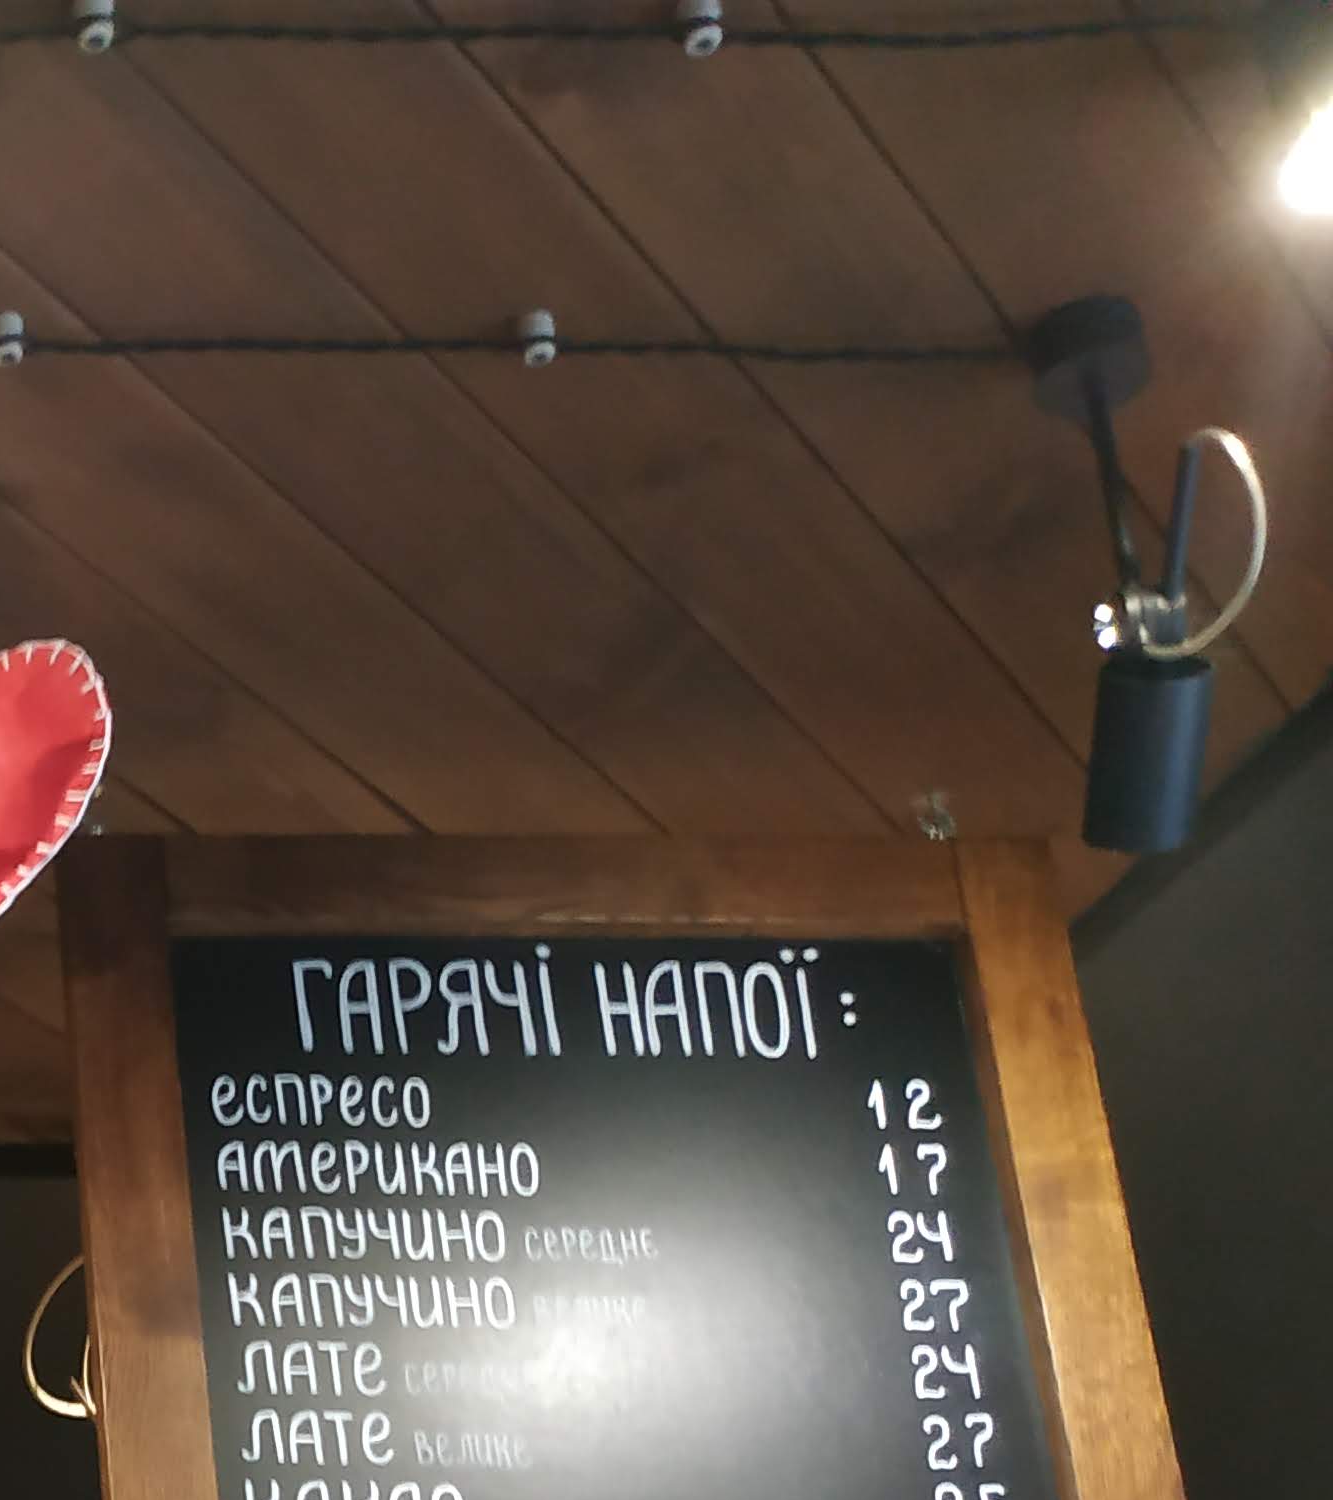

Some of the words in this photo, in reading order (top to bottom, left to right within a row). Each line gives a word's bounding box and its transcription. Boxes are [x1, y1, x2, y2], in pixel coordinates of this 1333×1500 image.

[291, 943, 562, 1057] ГАРЯЧІ
[867, 1078, 942, 1130] 12
[217, 1140, 540, 1198] АМЕРИКАНО
[878, 1142, 946, 1196] 17
[221, 1205, 507, 1264] КАПУЧИНО
[886, 1209, 954, 1264] 24
[227, 1272, 518, 1330] КАПУЧИНО
[900, 1278, 969, 1331] 27
[237, 1340, 388, 1397] ЛАТЕ
[911, 1343, 981, 1400] 24
[241, 1408, 394, 1466] ЛАТЕ
[923, 1412, 993, 1470] 27
